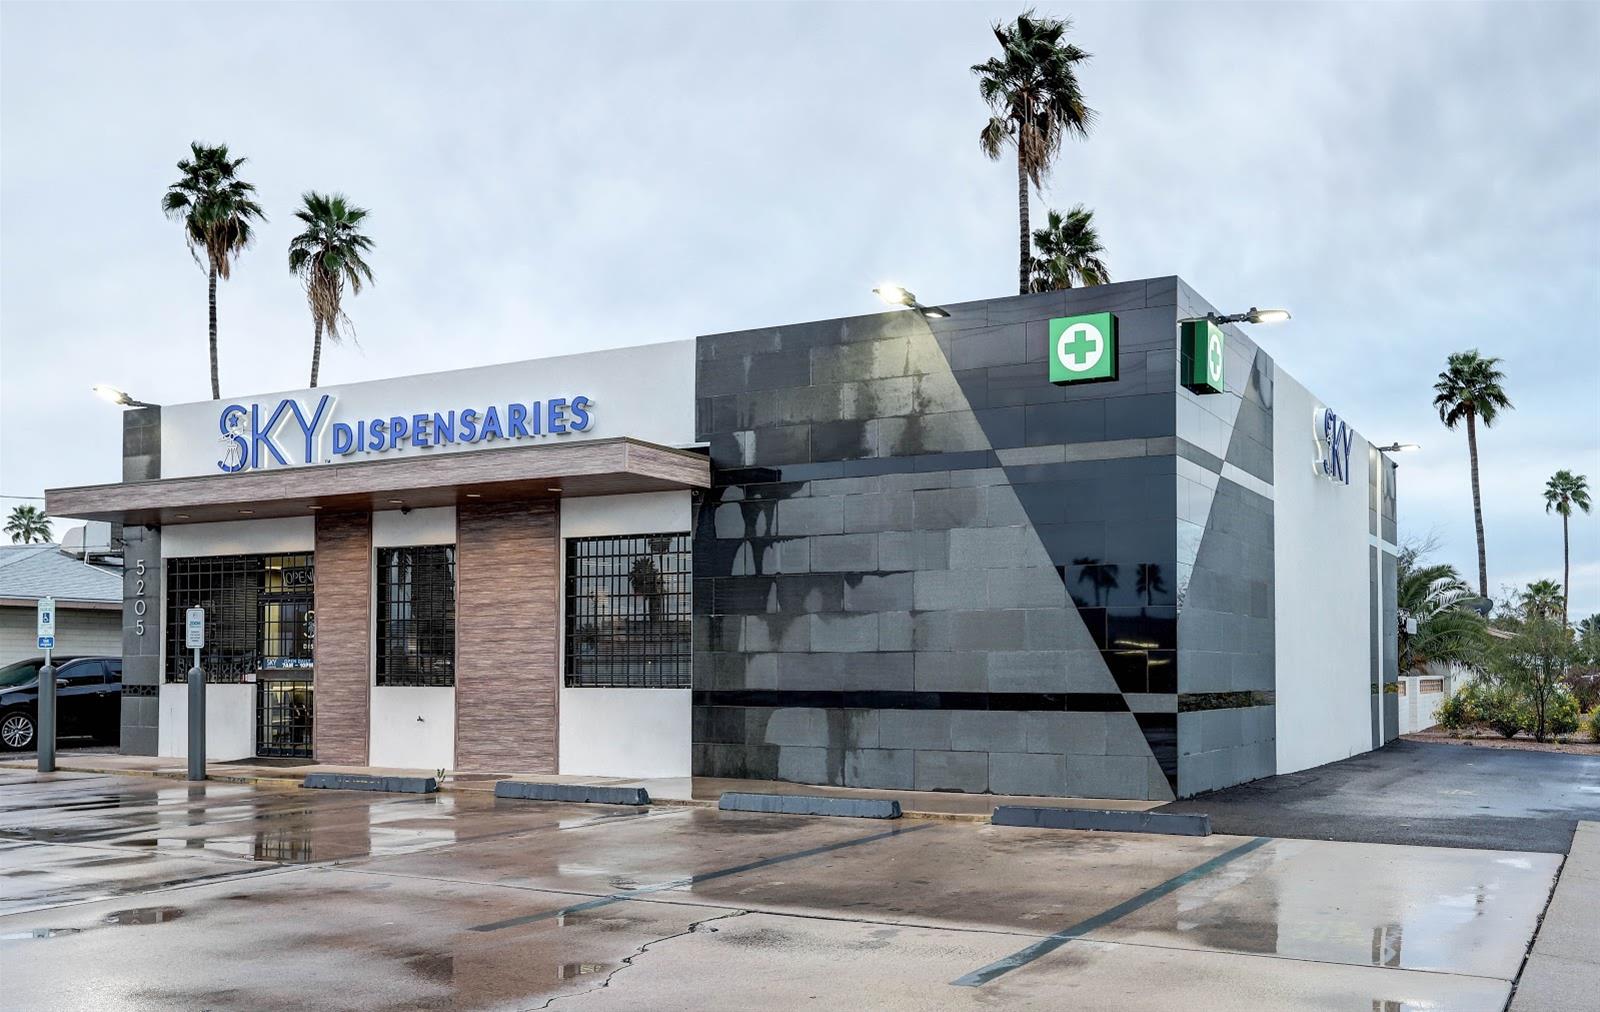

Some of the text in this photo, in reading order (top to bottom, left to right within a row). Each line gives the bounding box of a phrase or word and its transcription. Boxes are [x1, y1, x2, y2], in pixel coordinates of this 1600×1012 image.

[218, 394, 330, 473] SKY
[332, 395, 592, 455] DISPENSARIES
[1323, 408, 1353, 484] SKY
[134, 559, 147, 636] 5205
[285, 570, 314, 585] OPEN
